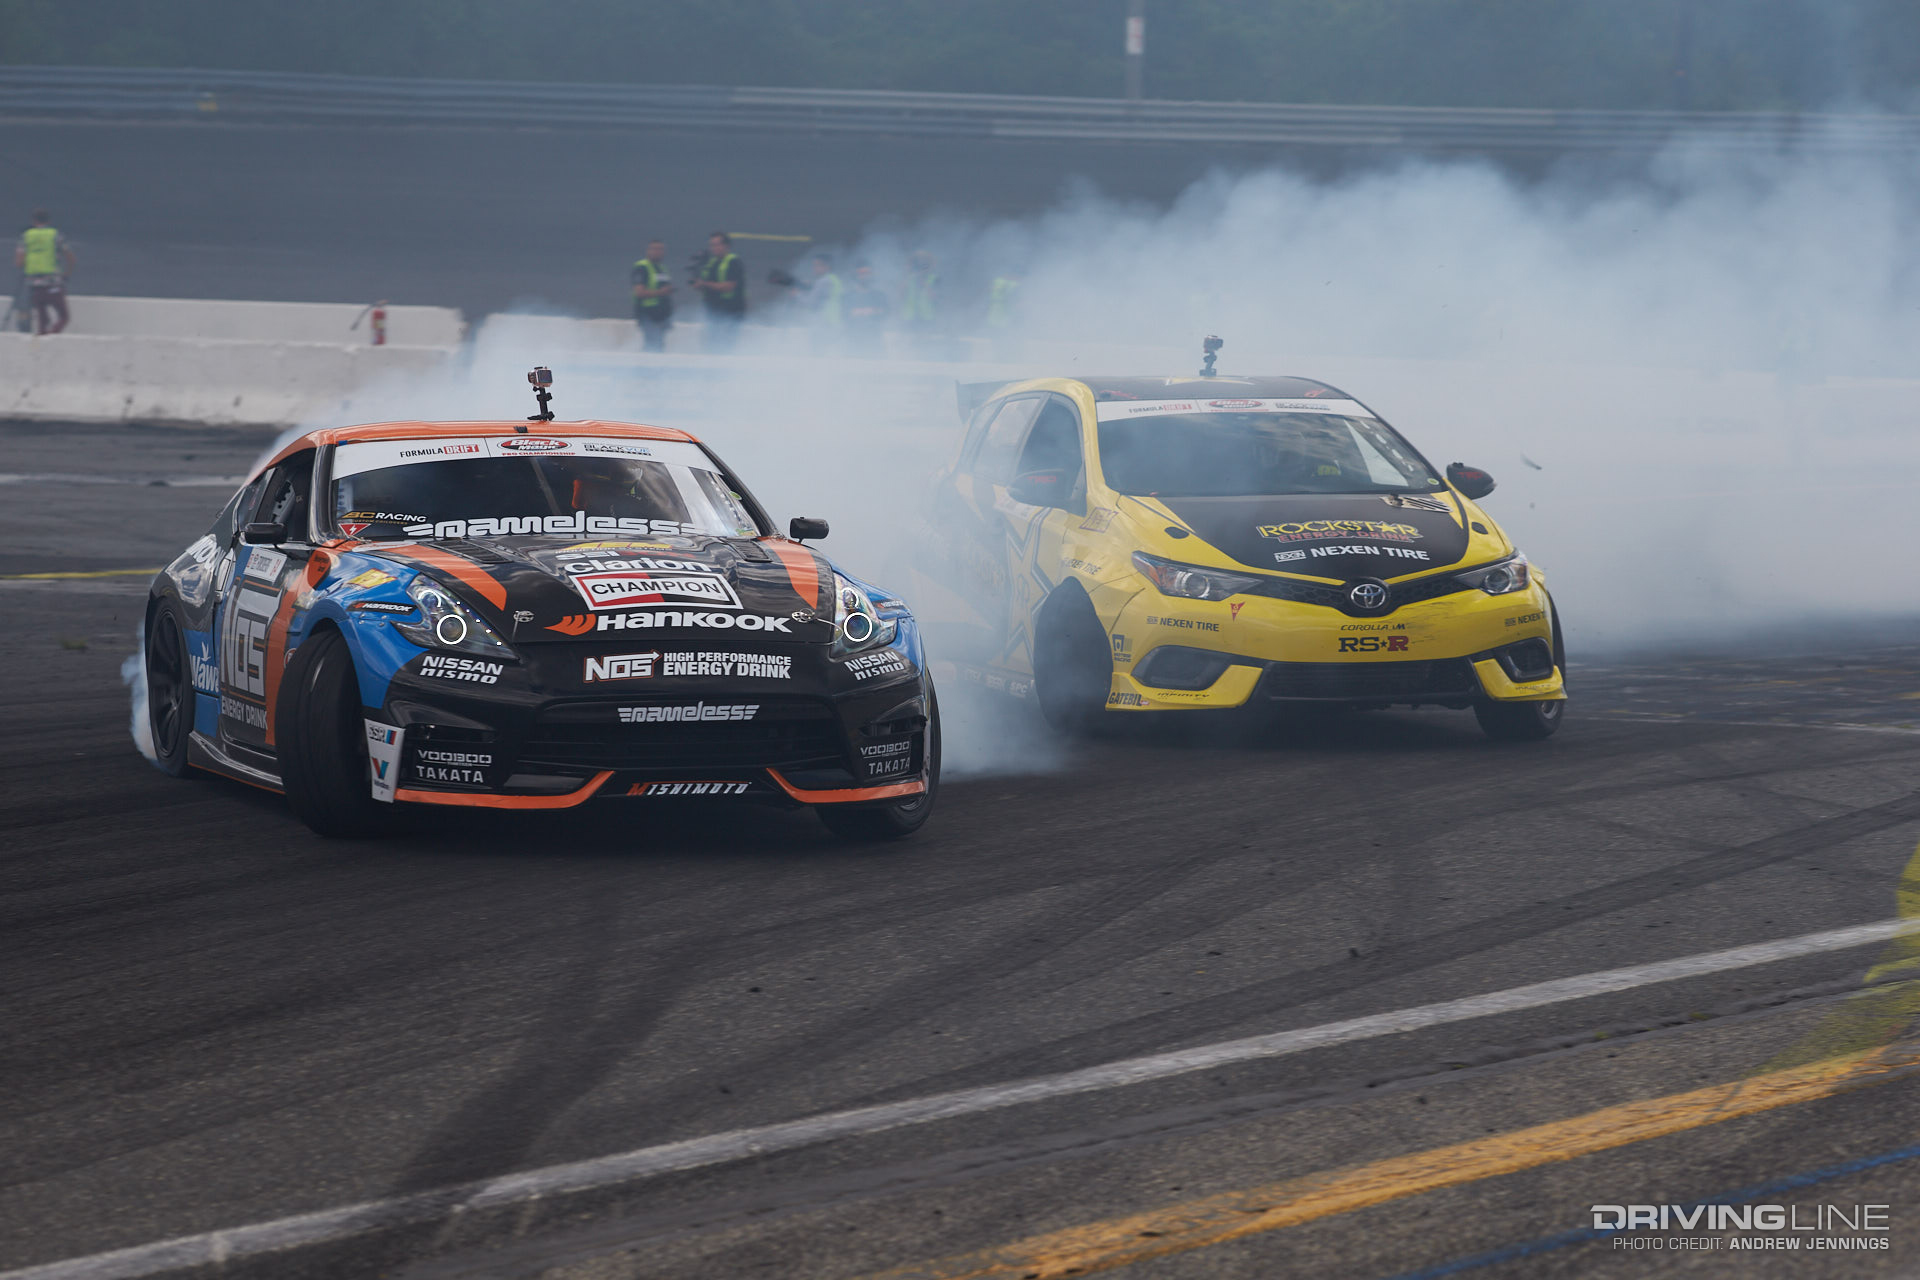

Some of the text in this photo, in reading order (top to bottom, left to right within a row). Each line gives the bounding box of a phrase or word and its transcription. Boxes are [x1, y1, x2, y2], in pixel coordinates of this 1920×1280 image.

[400, 444, 478, 458] FORMULA DRIFT
[342, 511, 427, 523] BC RACING
[1280, 530, 1410, 542] ENERGY DRINK
[1310, 545, 1380, 557] NEXEN
[1382, 547, 1430, 560] TIRE
[564, 557, 712, 573] clarion
[591, 581, 722, 595] CHAMPION
[1160, 617, 1193, 629] NEXEN
[1196, 621, 1220, 632] TIRE
[221, 583, 283, 697] NOS
[422, 655, 504, 675] NISSAN
[584, 651, 662, 682] NOS
[664, 652, 791, 666] HIGH PERFORMANCE
[844, 651, 900, 672] NISSAN
[419, 667, 498, 684] nismo
[663, 662, 791, 679] ENERGY DRINK
[854, 662, 905, 681] nismo
[1109, 692, 1142, 706] GATEBIL
[222, 695, 268, 730] ENERGY DRINK
[629, 701, 746, 723] nameless
[416, 765, 484, 783] TAKATA
[869, 757, 911, 776] TAKATA
[627, 782, 748, 796] MISHIMOTO
